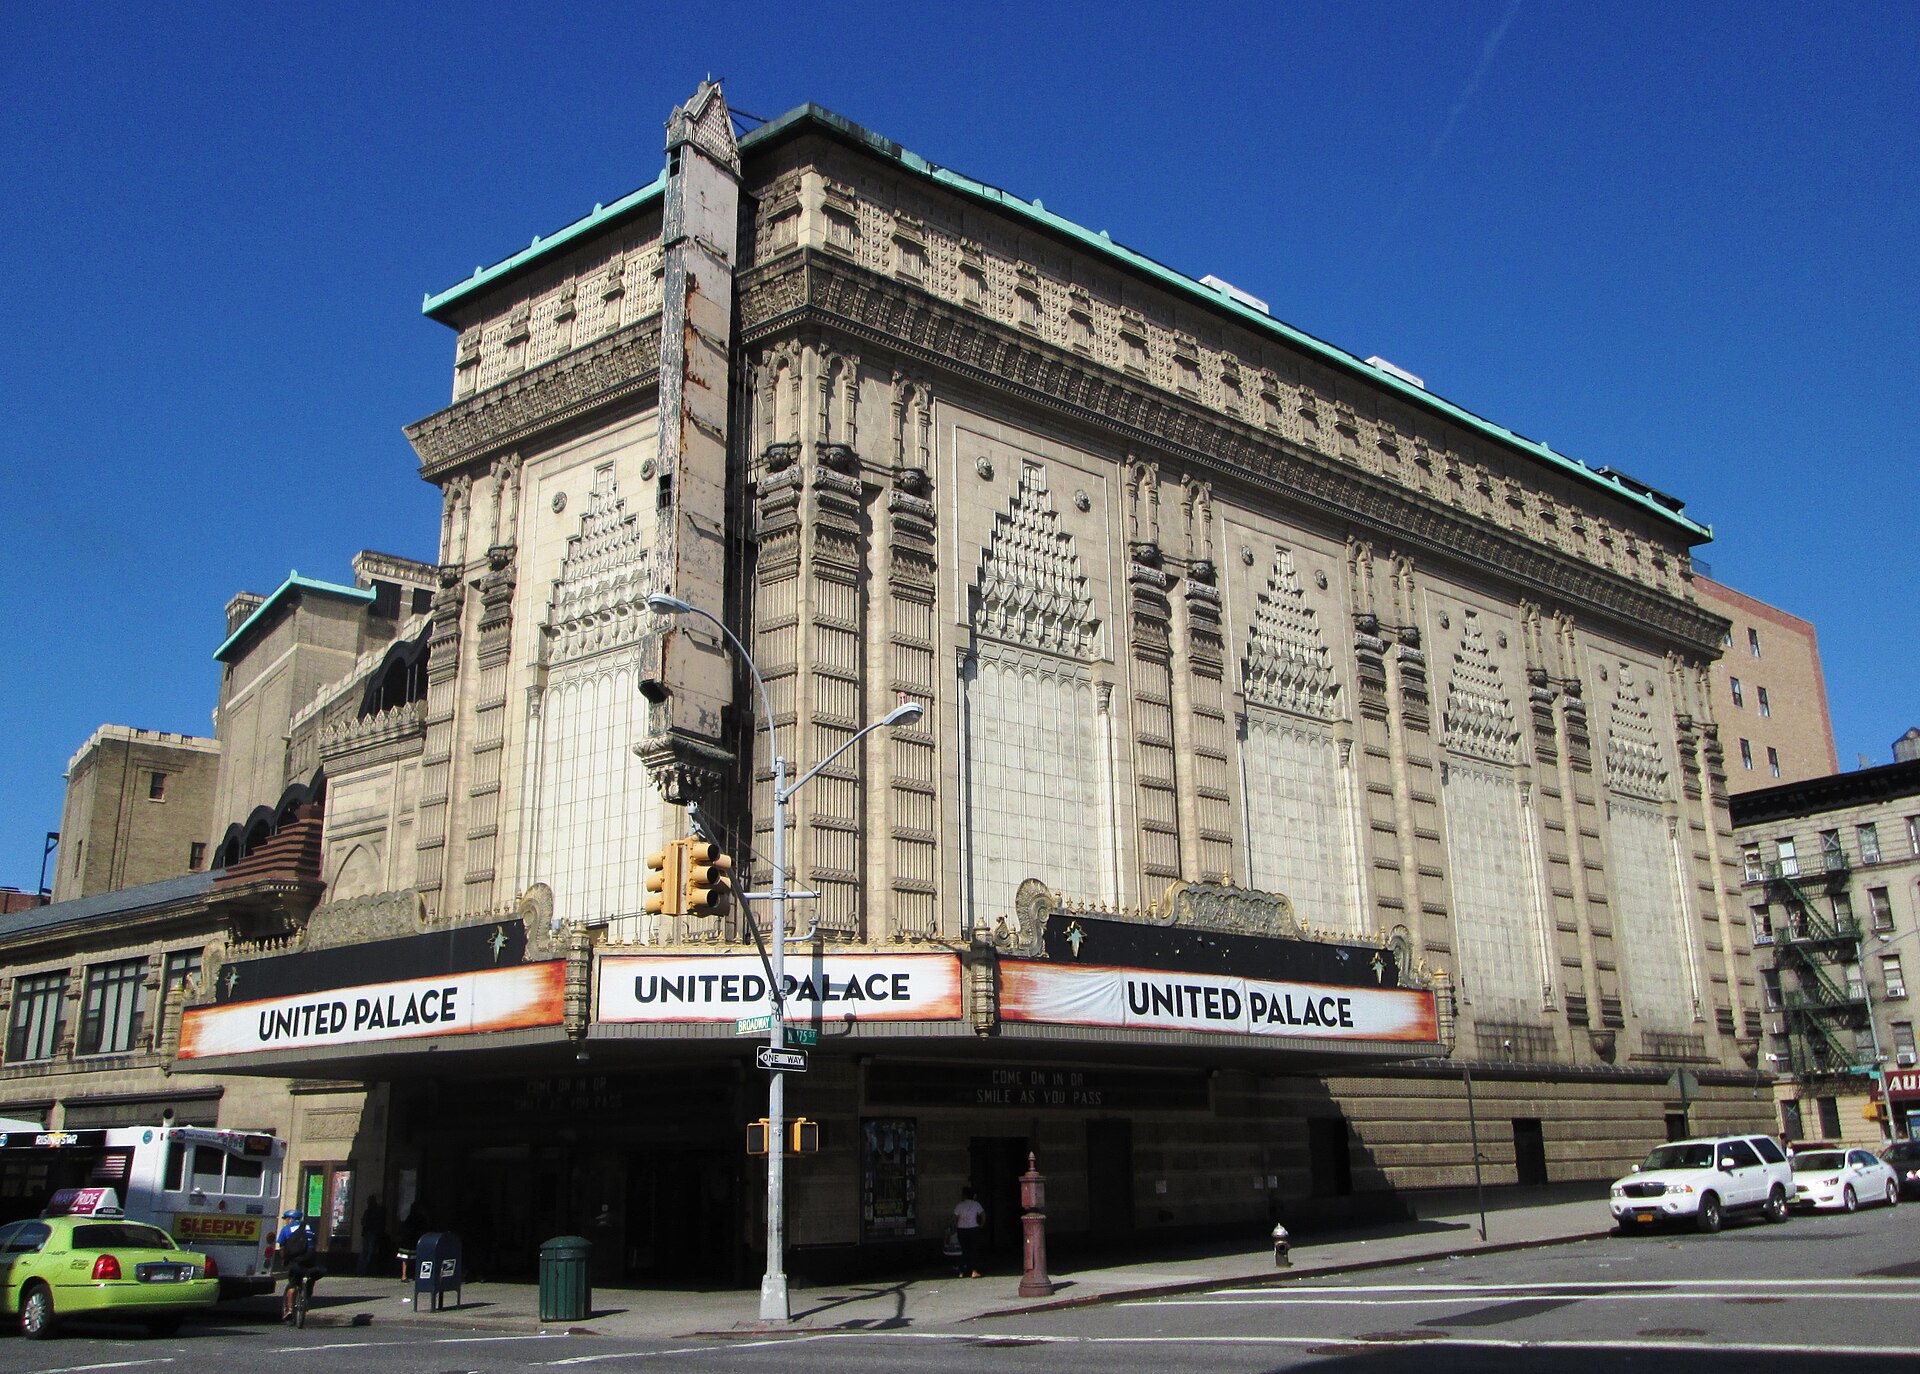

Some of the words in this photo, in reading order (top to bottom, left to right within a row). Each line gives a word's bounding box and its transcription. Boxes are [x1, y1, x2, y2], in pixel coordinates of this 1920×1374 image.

[634, 975, 766, 1003] UNITED
[781, 973, 911, 1002] PALACE
[1127, 981, 1242, 1020] UNITED
[1249, 991, 1354, 1028] PALACE
[259, 1001, 348, 1042] UNITED
[354, 987, 458, 1031] PALACE
[738, 1016, 770, 1033] BROADWAY
[808, 1031, 816, 1039] ST
[762, 1053, 780, 1063] ONE
[787, 1055, 803, 1064] WAY
[992, 1069, 1023, 1085] COME
[1030, 1071, 1046, 1085] ON
[1053, 1072, 1065, 1086] IN
[1071, 1072, 1085, 1087] OR
[1877, 1074, 1920, 1092] AU
[976, 1088, 1012, 1104] SMILE
[1020, 1089, 1036, 1104] AS
[1043, 1090, 1066, 1105] YOU
[1073, 1091, 1103, 1106] PASS
[60, 1134, 79, 1145] STAR
